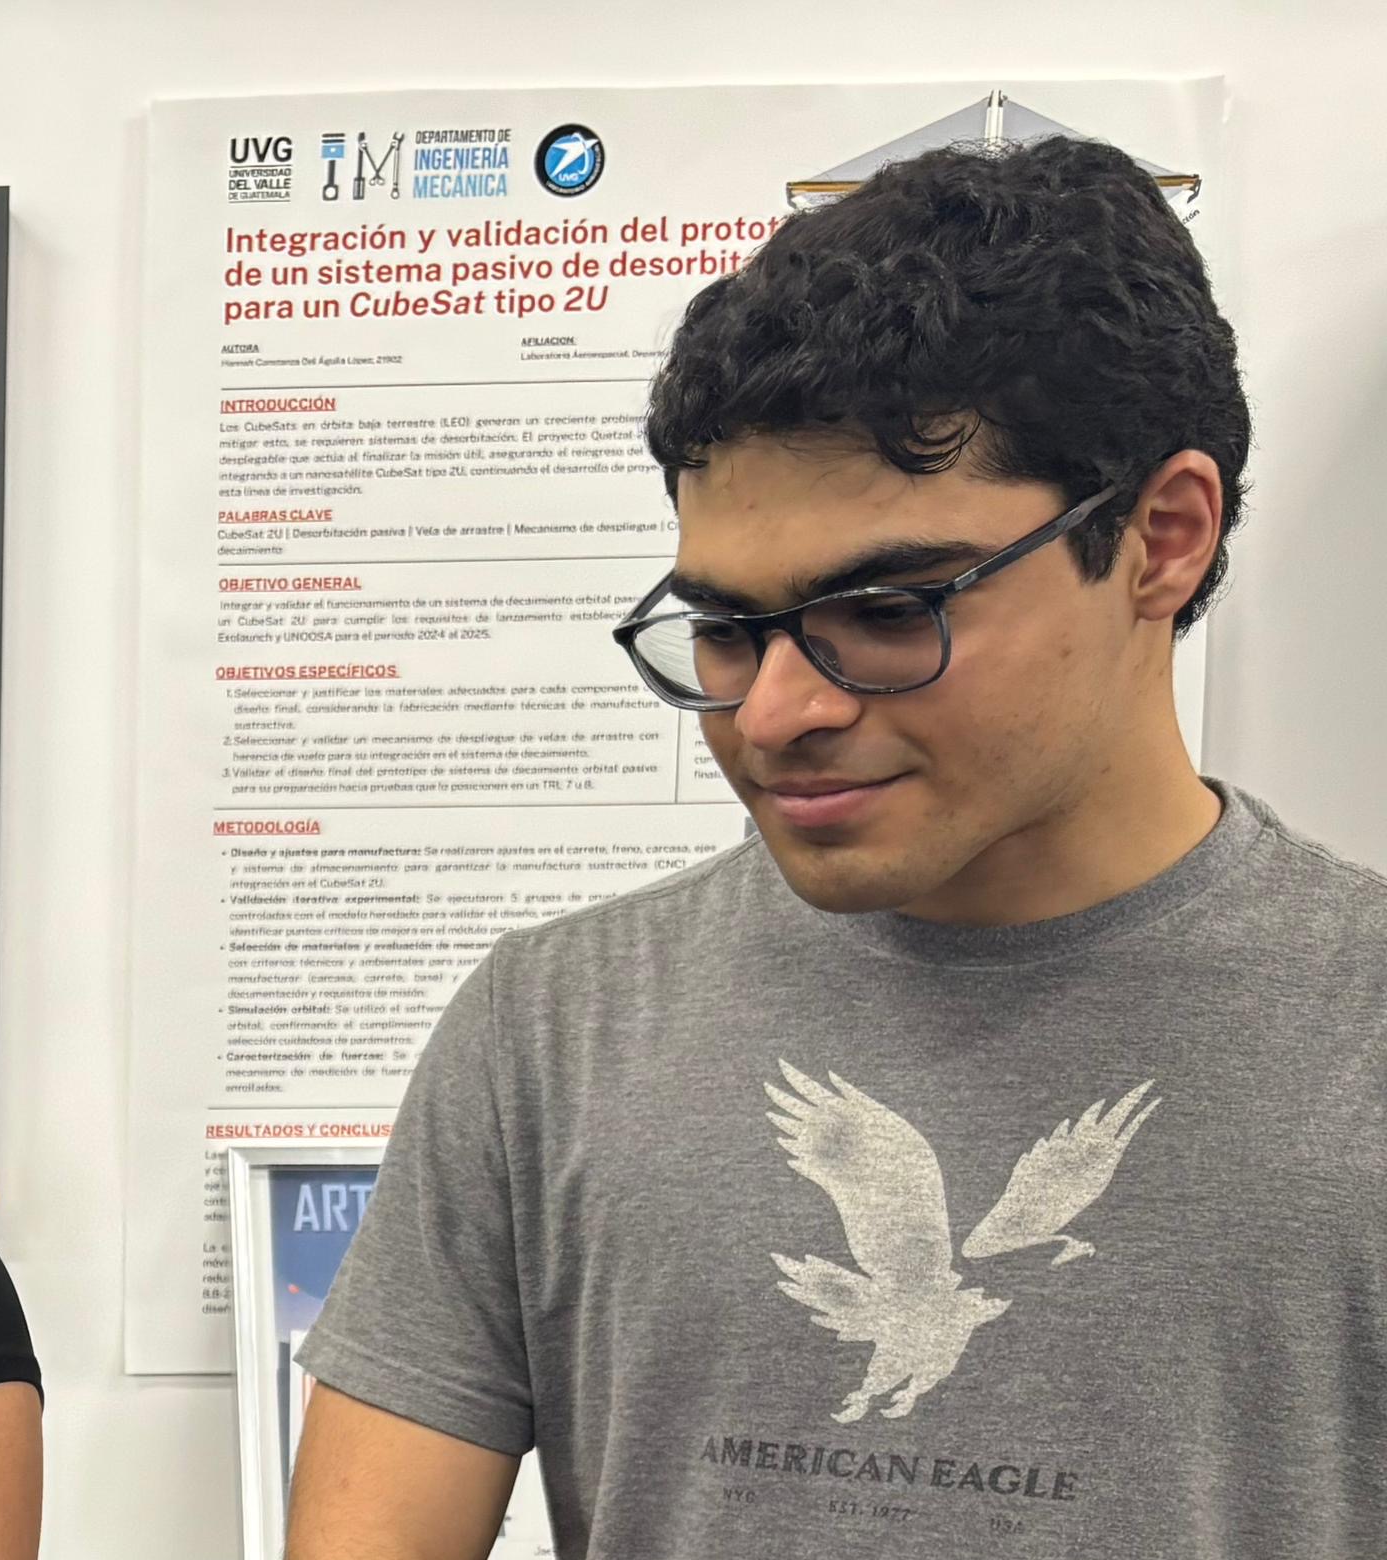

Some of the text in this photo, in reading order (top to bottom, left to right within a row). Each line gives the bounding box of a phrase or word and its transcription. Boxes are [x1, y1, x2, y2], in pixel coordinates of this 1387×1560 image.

[415, 128, 512, 144] DEPARTAMENTO DE
[230, 137, 293, 163] UVG
[413, 144, 510, 173] INGENIERÍA
[229, 178, 291, 191] DEL VALLE
[413, 170, 509, 199] MECÁNICA
[226, 216, 779, 257] Integración y validación del protot
[225, 249, 745, 287] de un sistema pasivo de desorbit
[225, 285, 609, 324] para un CubeSat tipo 2U
[220, 397, 336, 413] INTRODUCCIÓN
[218, 509, 332, 523] PALABRAS CLAVE
[219, 577, 362, 591] OBJETIVO GENERAL
[216, 664, 398, 679] OBJETIVOS ESPECÍFICOS
[213, 820, 320, 833] METODOLOGÍA
[206, 1124, 392, 1138] RESULTADOS Y CONCLUS
[293, 1182, 375, 1233] ART
[700, 1436, 1079, 1502] AMERICAN EAGLE
[870, 1504, 911, 1521] 1977
